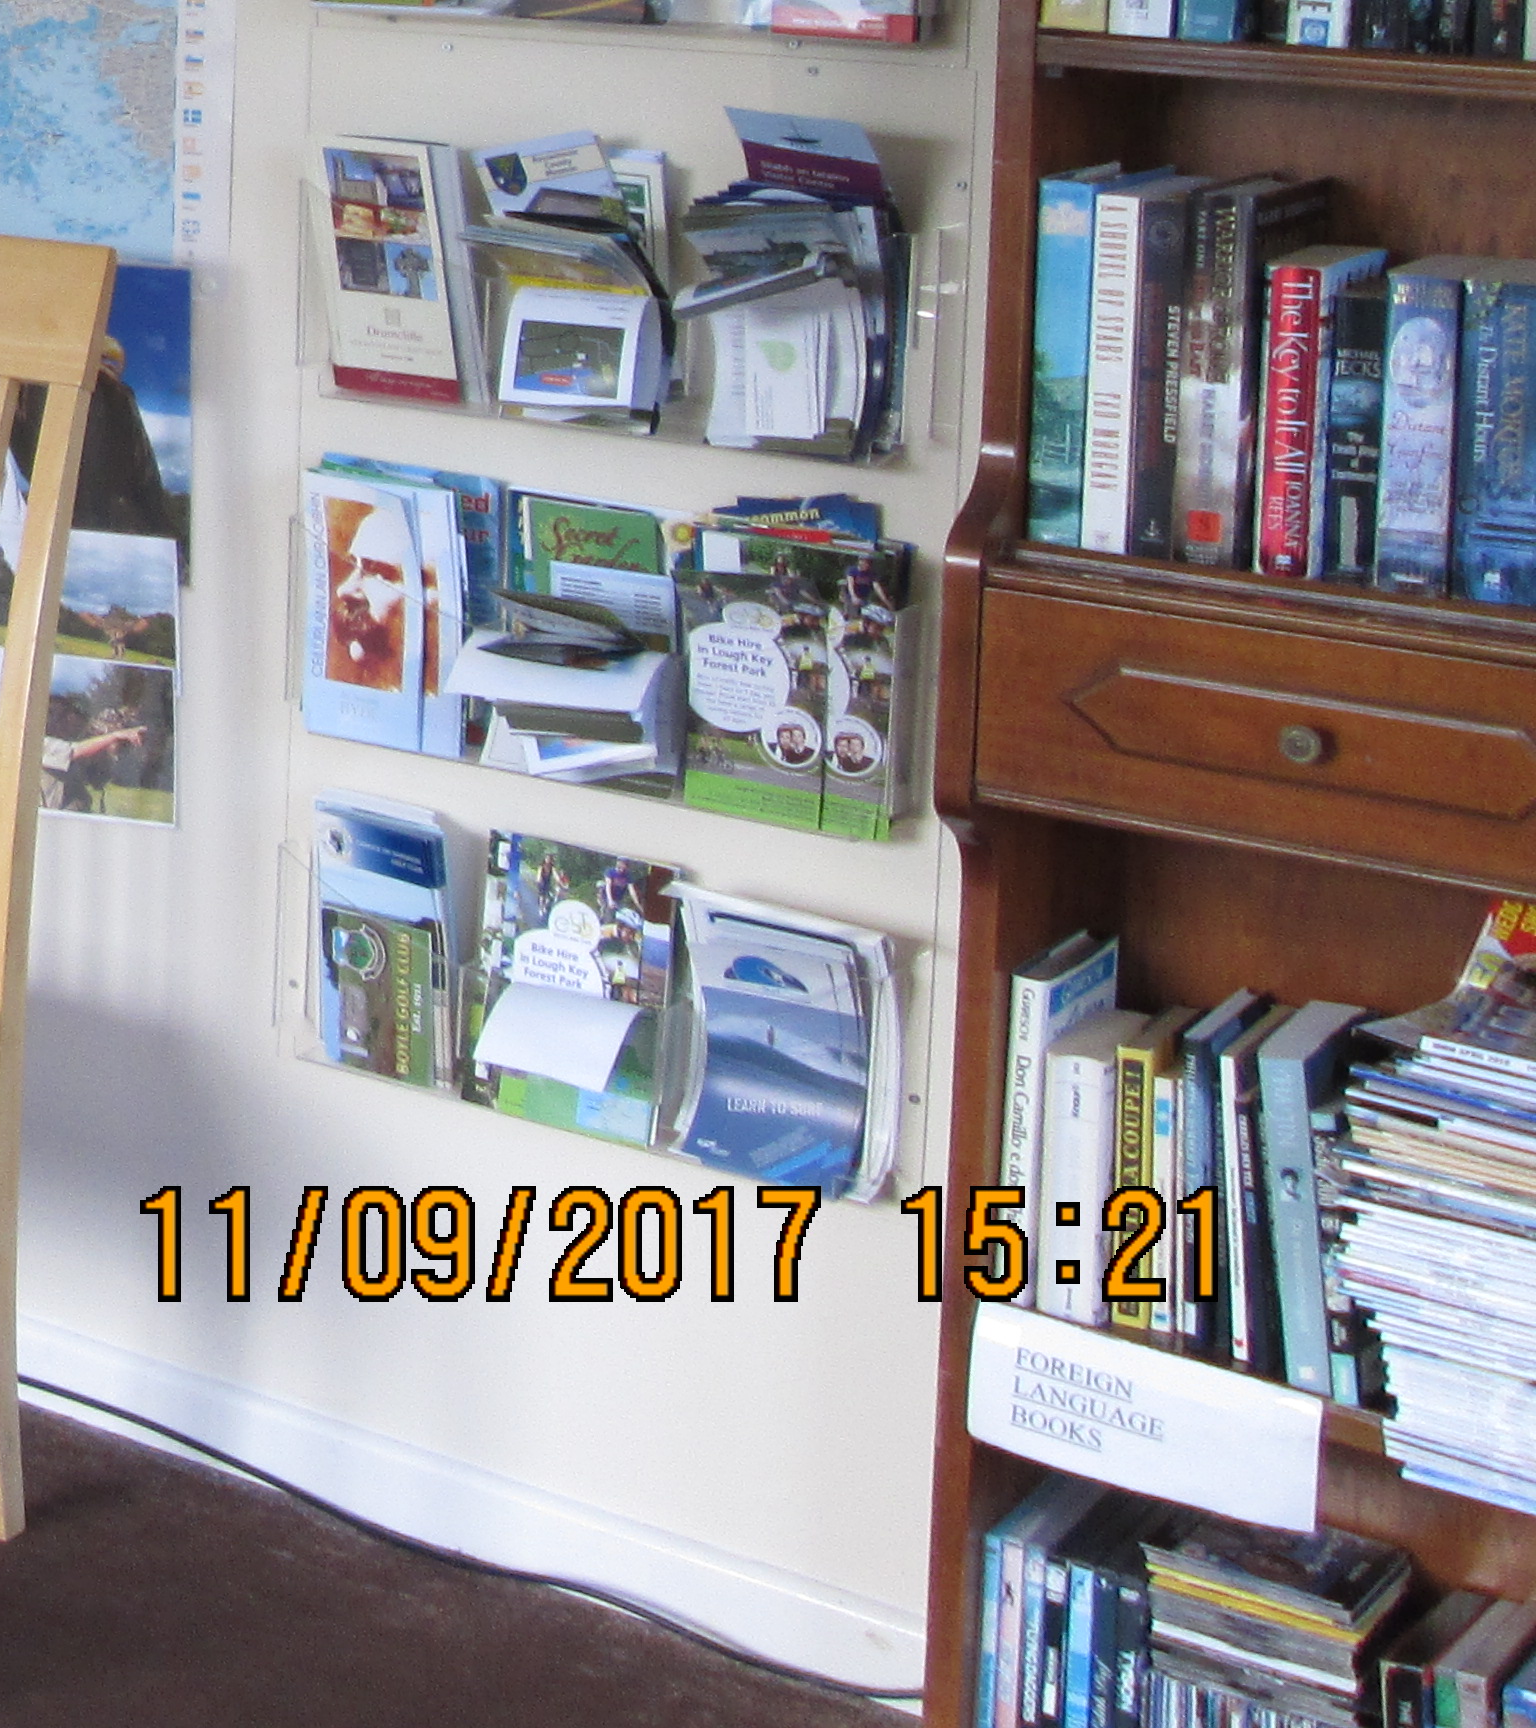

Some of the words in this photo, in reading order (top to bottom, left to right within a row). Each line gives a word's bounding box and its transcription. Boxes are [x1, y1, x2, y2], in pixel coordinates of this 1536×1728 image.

[1212, 206, 1237, 299] WARRIOR
[1281, 275, 1314, 326] The
[1095, 316, 1124, 364] STARS
[1166, 305, 1180, 358] STEVEN
[1500, 303, 1527, 364] KATE
[1270, 331, 1311, 382] Key
[1475, 346, 1498, 406] Distant
[1163, 361, 1178, 443] PRESSFIELD
[1277, 388, 1301, 412] to
[1273, 440, 1308, 474] All
[1473, 411, 1493, 463] Hours
[1267, 496, 1285, 531] REES
[1284, 480, 1303, 548] JOANNA
[709, 634, 734, 647] Bike
[737, 638, 762, 650] Hire
[711, 647, 748, 662] Lough
[751, 653, 773, 667] Key
[703, 658, 738, 673] Forest
[741, 663, 767, 677] Park
[397, 932, 412, 975] CLUB
[530, 942, 555, 957] Bike
[556, 947, 579, 962] Hire
[532, 954, 566, 972] Lough
[568, 963, 589, 980] Key
[395, 977, 411, 1023] GOLF
[524, 967, 556, 983] Forest
[558, 974, 582, 989] Park
[395, 1025, 411, 1076] BOYLE
[1013, 1055, 1031, 1087] Don
[726, 1096, 766, 1114] LEARN
[769, 1099, 788, 1115] TO
[789, 1100, 824, 1117] SURF
[1010, 1091, 1029, 1148] Camillo
[1122, 1083, 1140, 1159] COUPE
[1016, 1348, 1134, 1400] FOREIGN
[1011, 1405, 1103, 1448] BOOKS
[1013, 1376, 1164, 1438] LANGUAGE
